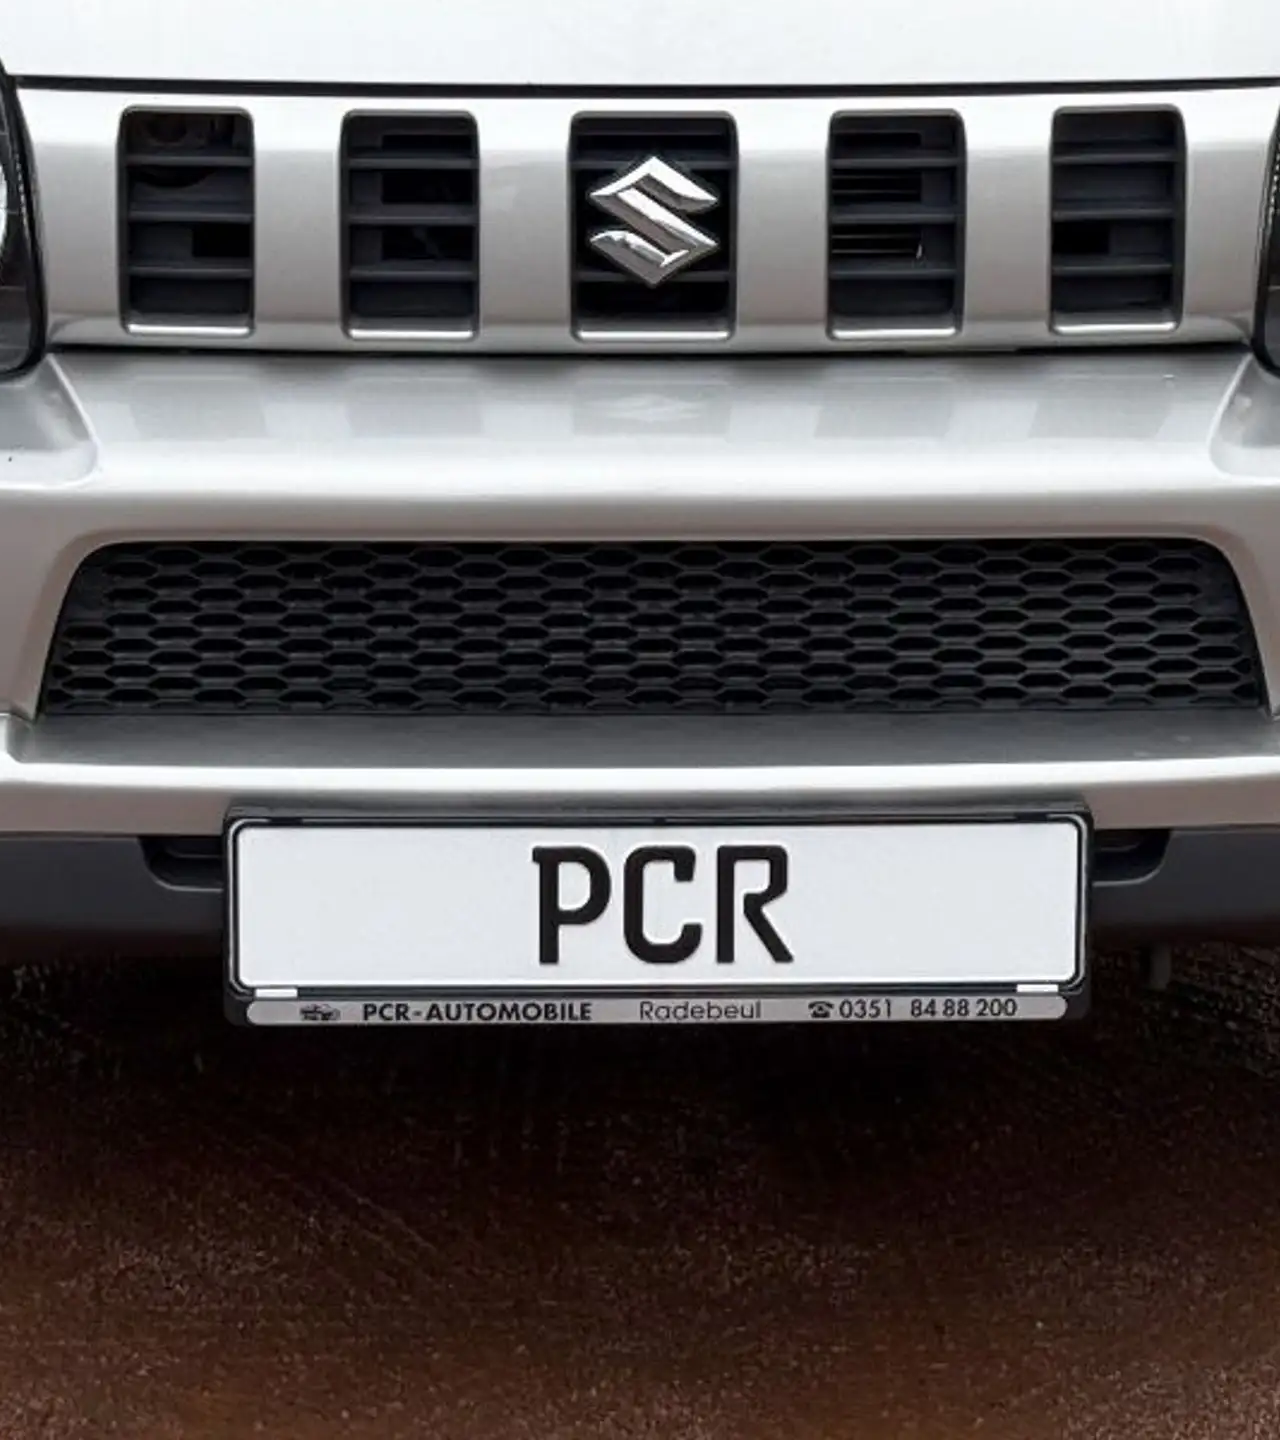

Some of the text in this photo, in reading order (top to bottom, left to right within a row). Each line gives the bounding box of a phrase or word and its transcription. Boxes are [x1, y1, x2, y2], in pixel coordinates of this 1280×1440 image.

[531, 845, 795, 965] PCR
[362, 1001, 593, 1023] PCR-AUTOMOBILE
[639, 1000, 762, 1021] Radebeul
[838, 998, 893, 1018] 0351
[910, 998, 938, 1018] 84
[975, 998, 1018, 1017] 200
